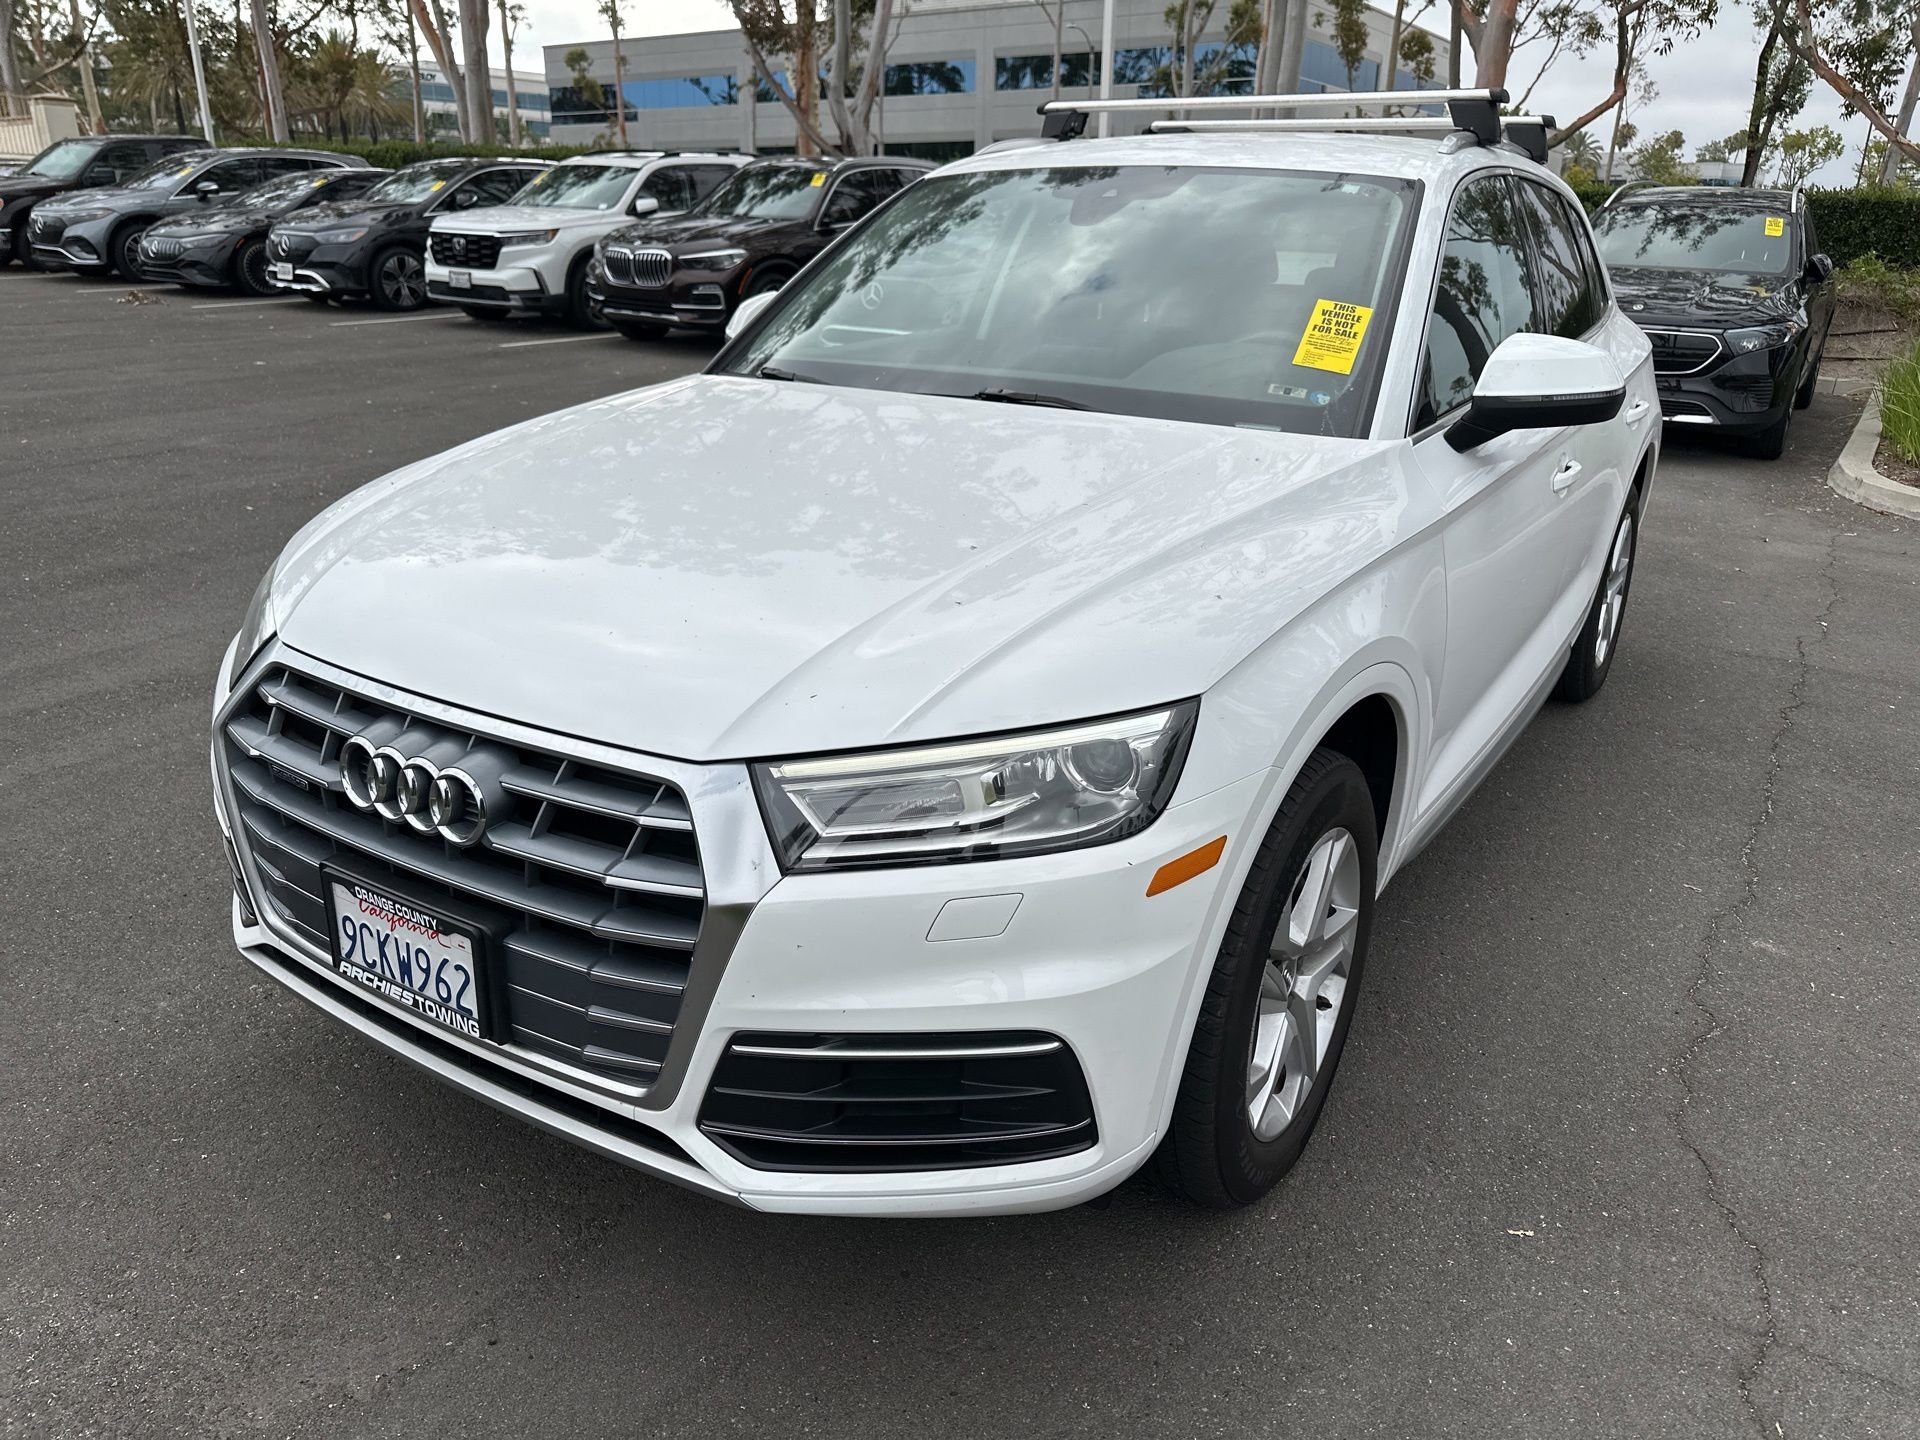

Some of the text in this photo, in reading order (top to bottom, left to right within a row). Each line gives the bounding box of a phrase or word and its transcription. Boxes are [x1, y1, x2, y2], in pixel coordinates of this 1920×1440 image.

[1321, 309, 1363, 323] VEHICLE
[1333, 303, 1357, 314] THIS
[1321, 317, 1356, 330] IS NOT
[1312, 324, 1359, 340] FOR SALE
[354, 886, 437, 931] ORANGE COUNTY
[341, 915, 473, 1017] 9CKW962
[339, 960, 480, 1038] ARCHIES TOWING
